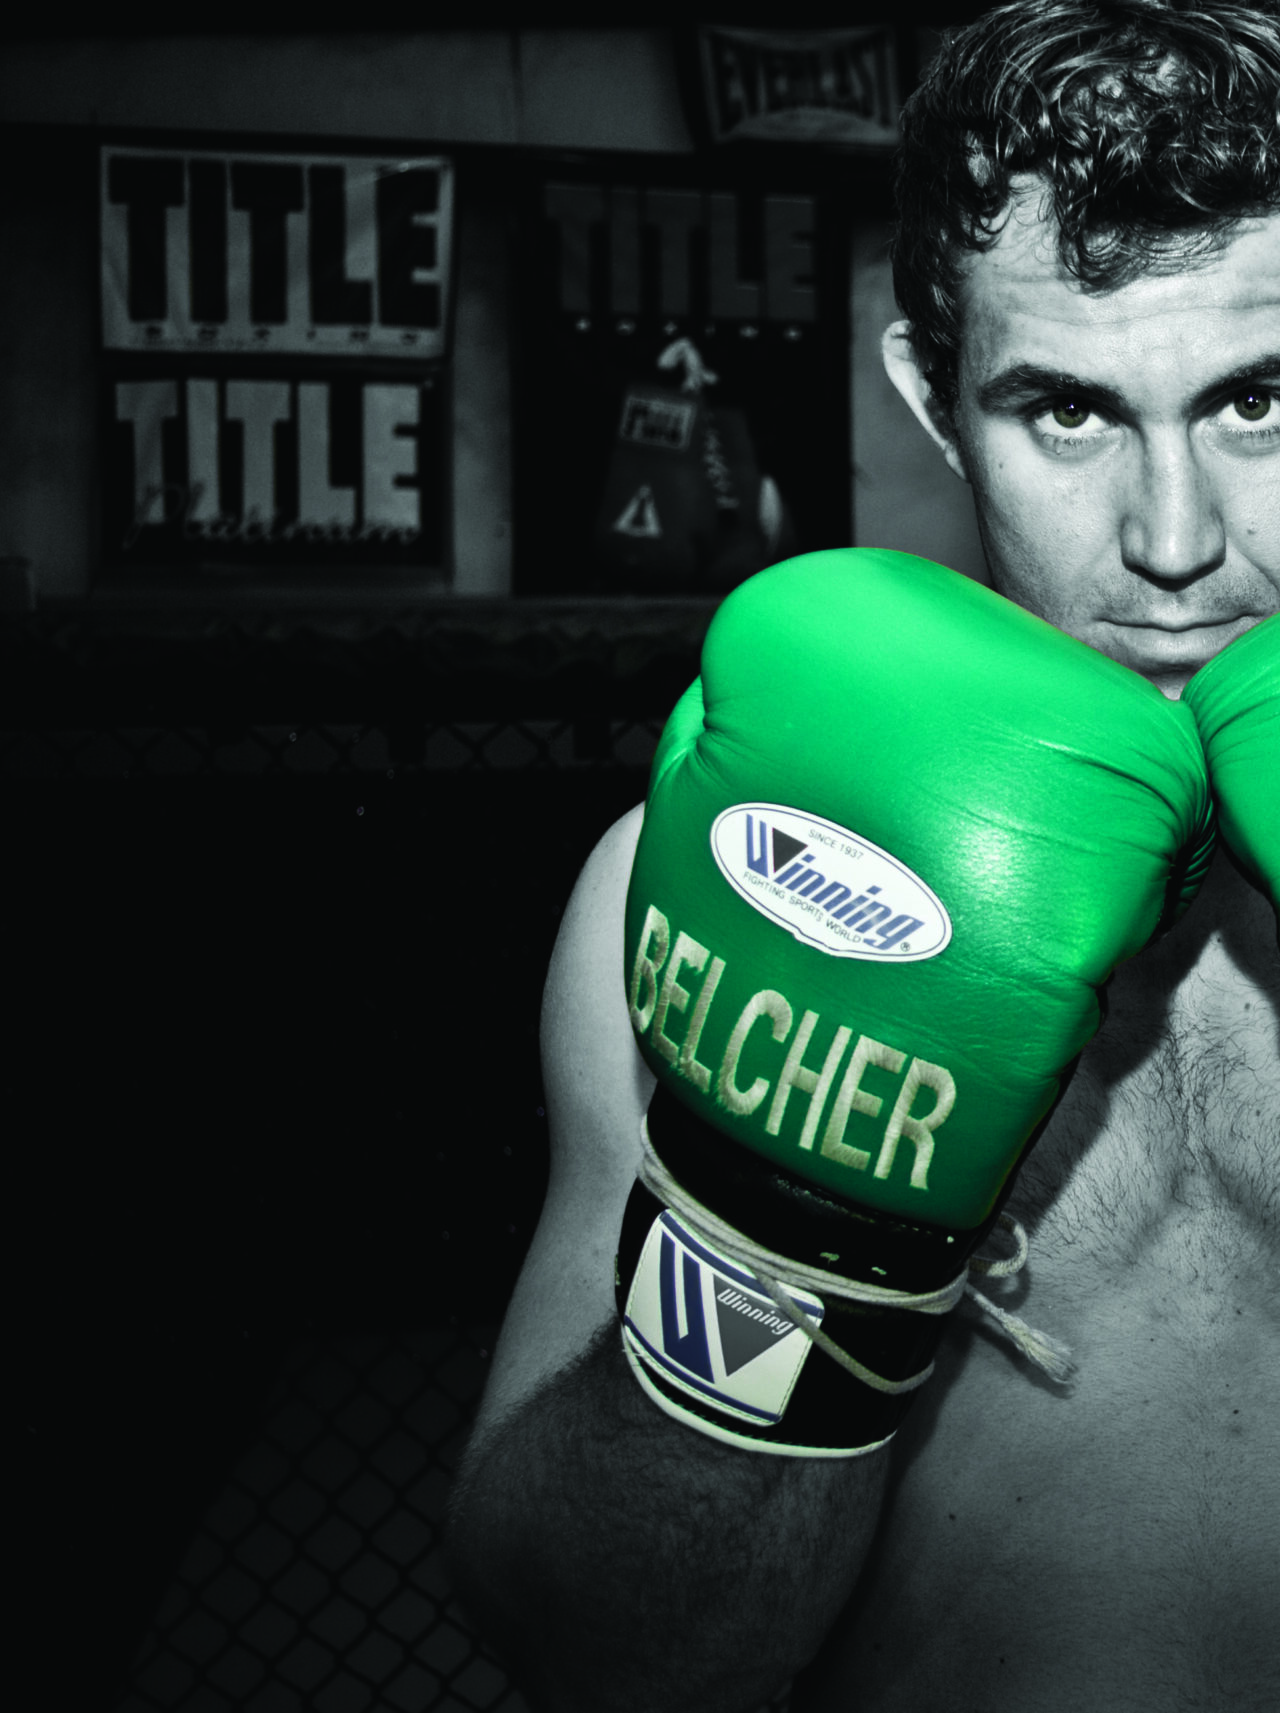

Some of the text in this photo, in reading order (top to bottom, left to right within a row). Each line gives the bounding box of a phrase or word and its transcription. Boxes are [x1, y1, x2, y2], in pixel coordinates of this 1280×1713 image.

[108, 155, 441, 328] TITLE
[543, 181, 818, 323] TITLE
[114, 377, 423, 527] TITLE
[742, 871, 862, 944] FIGHTING SPORTS WORLD
[745, 813, 926, 951] Winning
[808, 828, 865, 861] SINCE 1937
[630, 903, 957, 1191] BELCHER
[716, 1287, 795, 1336] Winning
